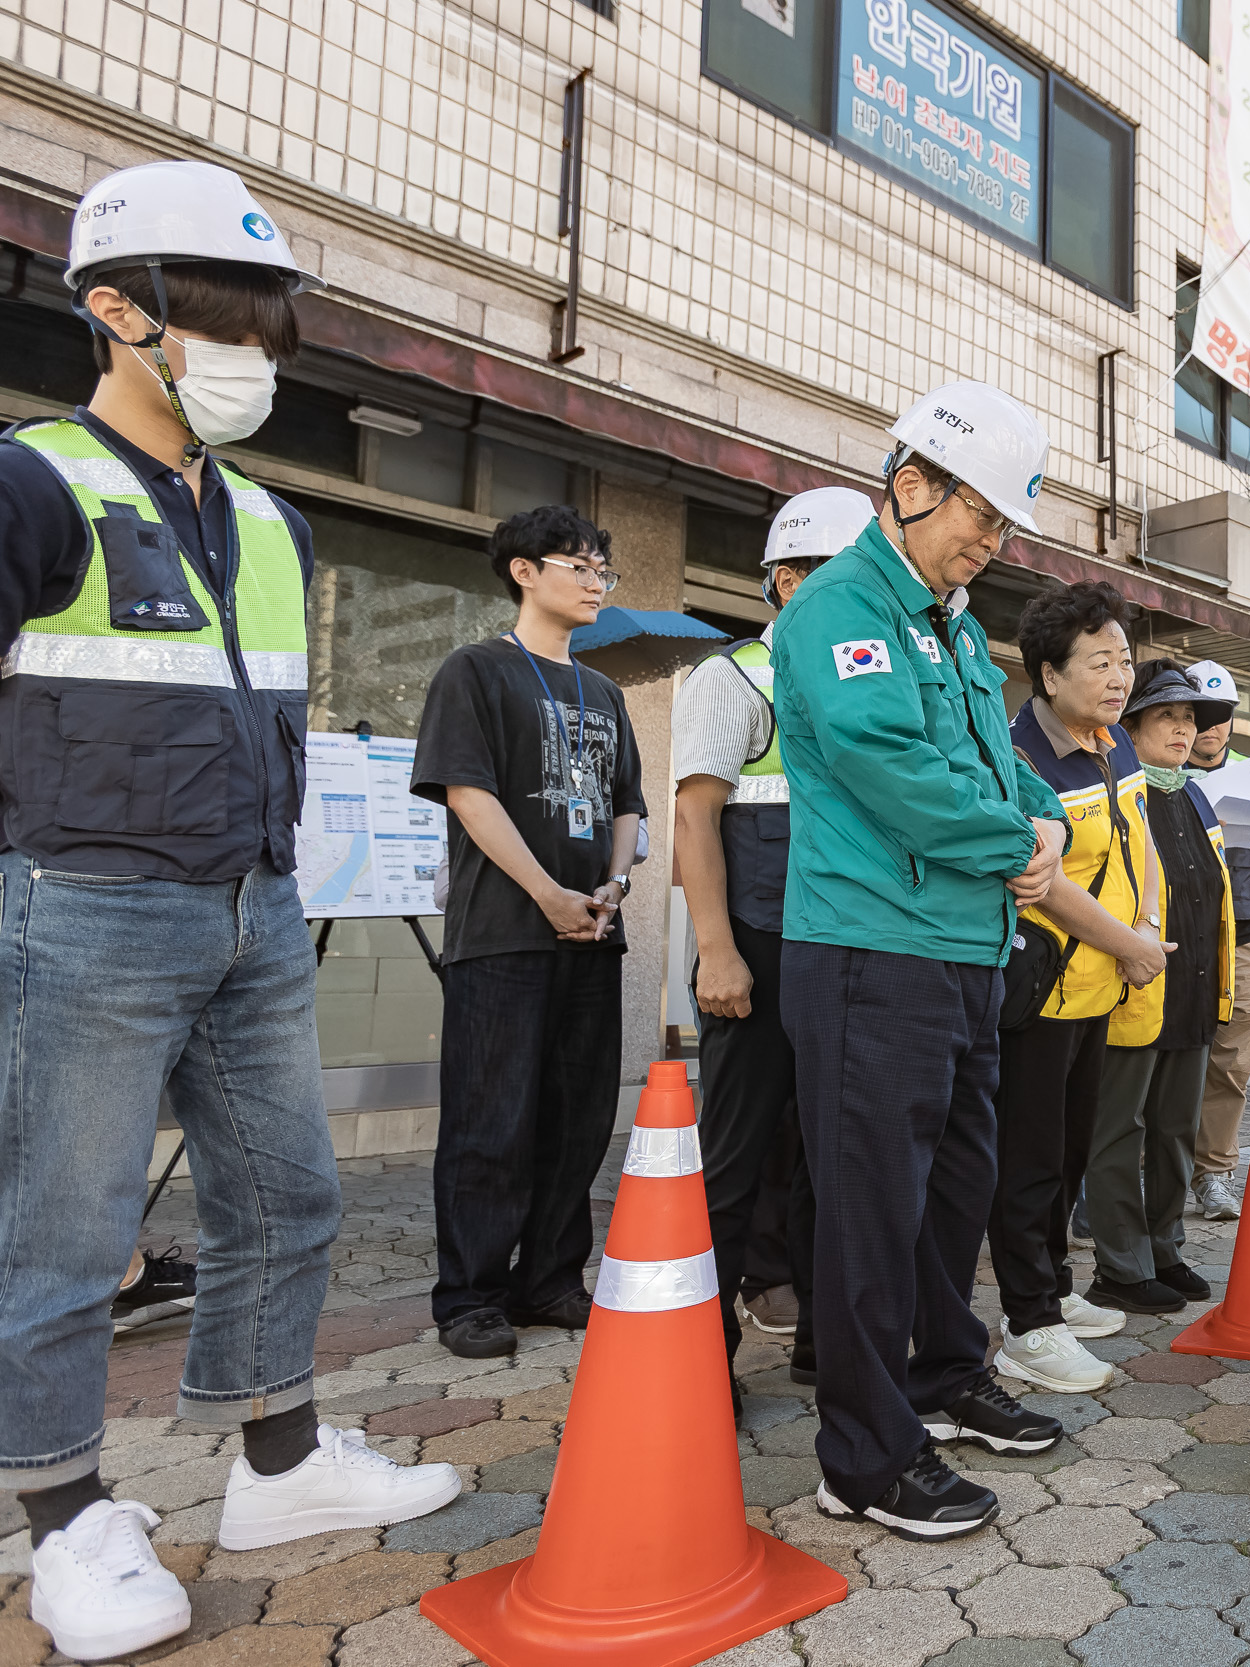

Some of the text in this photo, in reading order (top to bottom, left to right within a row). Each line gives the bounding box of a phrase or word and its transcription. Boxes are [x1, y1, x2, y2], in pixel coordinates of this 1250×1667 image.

[866, 0, 1021, 142] 한국기원
[882, 115, 1004, 210] 011-9031-7883
[1010, 191, 1030, 223] 2F
[914, 95, 984, 162] 초보자
[989, 140, 1031, 190] 지도
[933, 406, 975, 435] 광진구
[157, 602, 187, 613] 광진구
